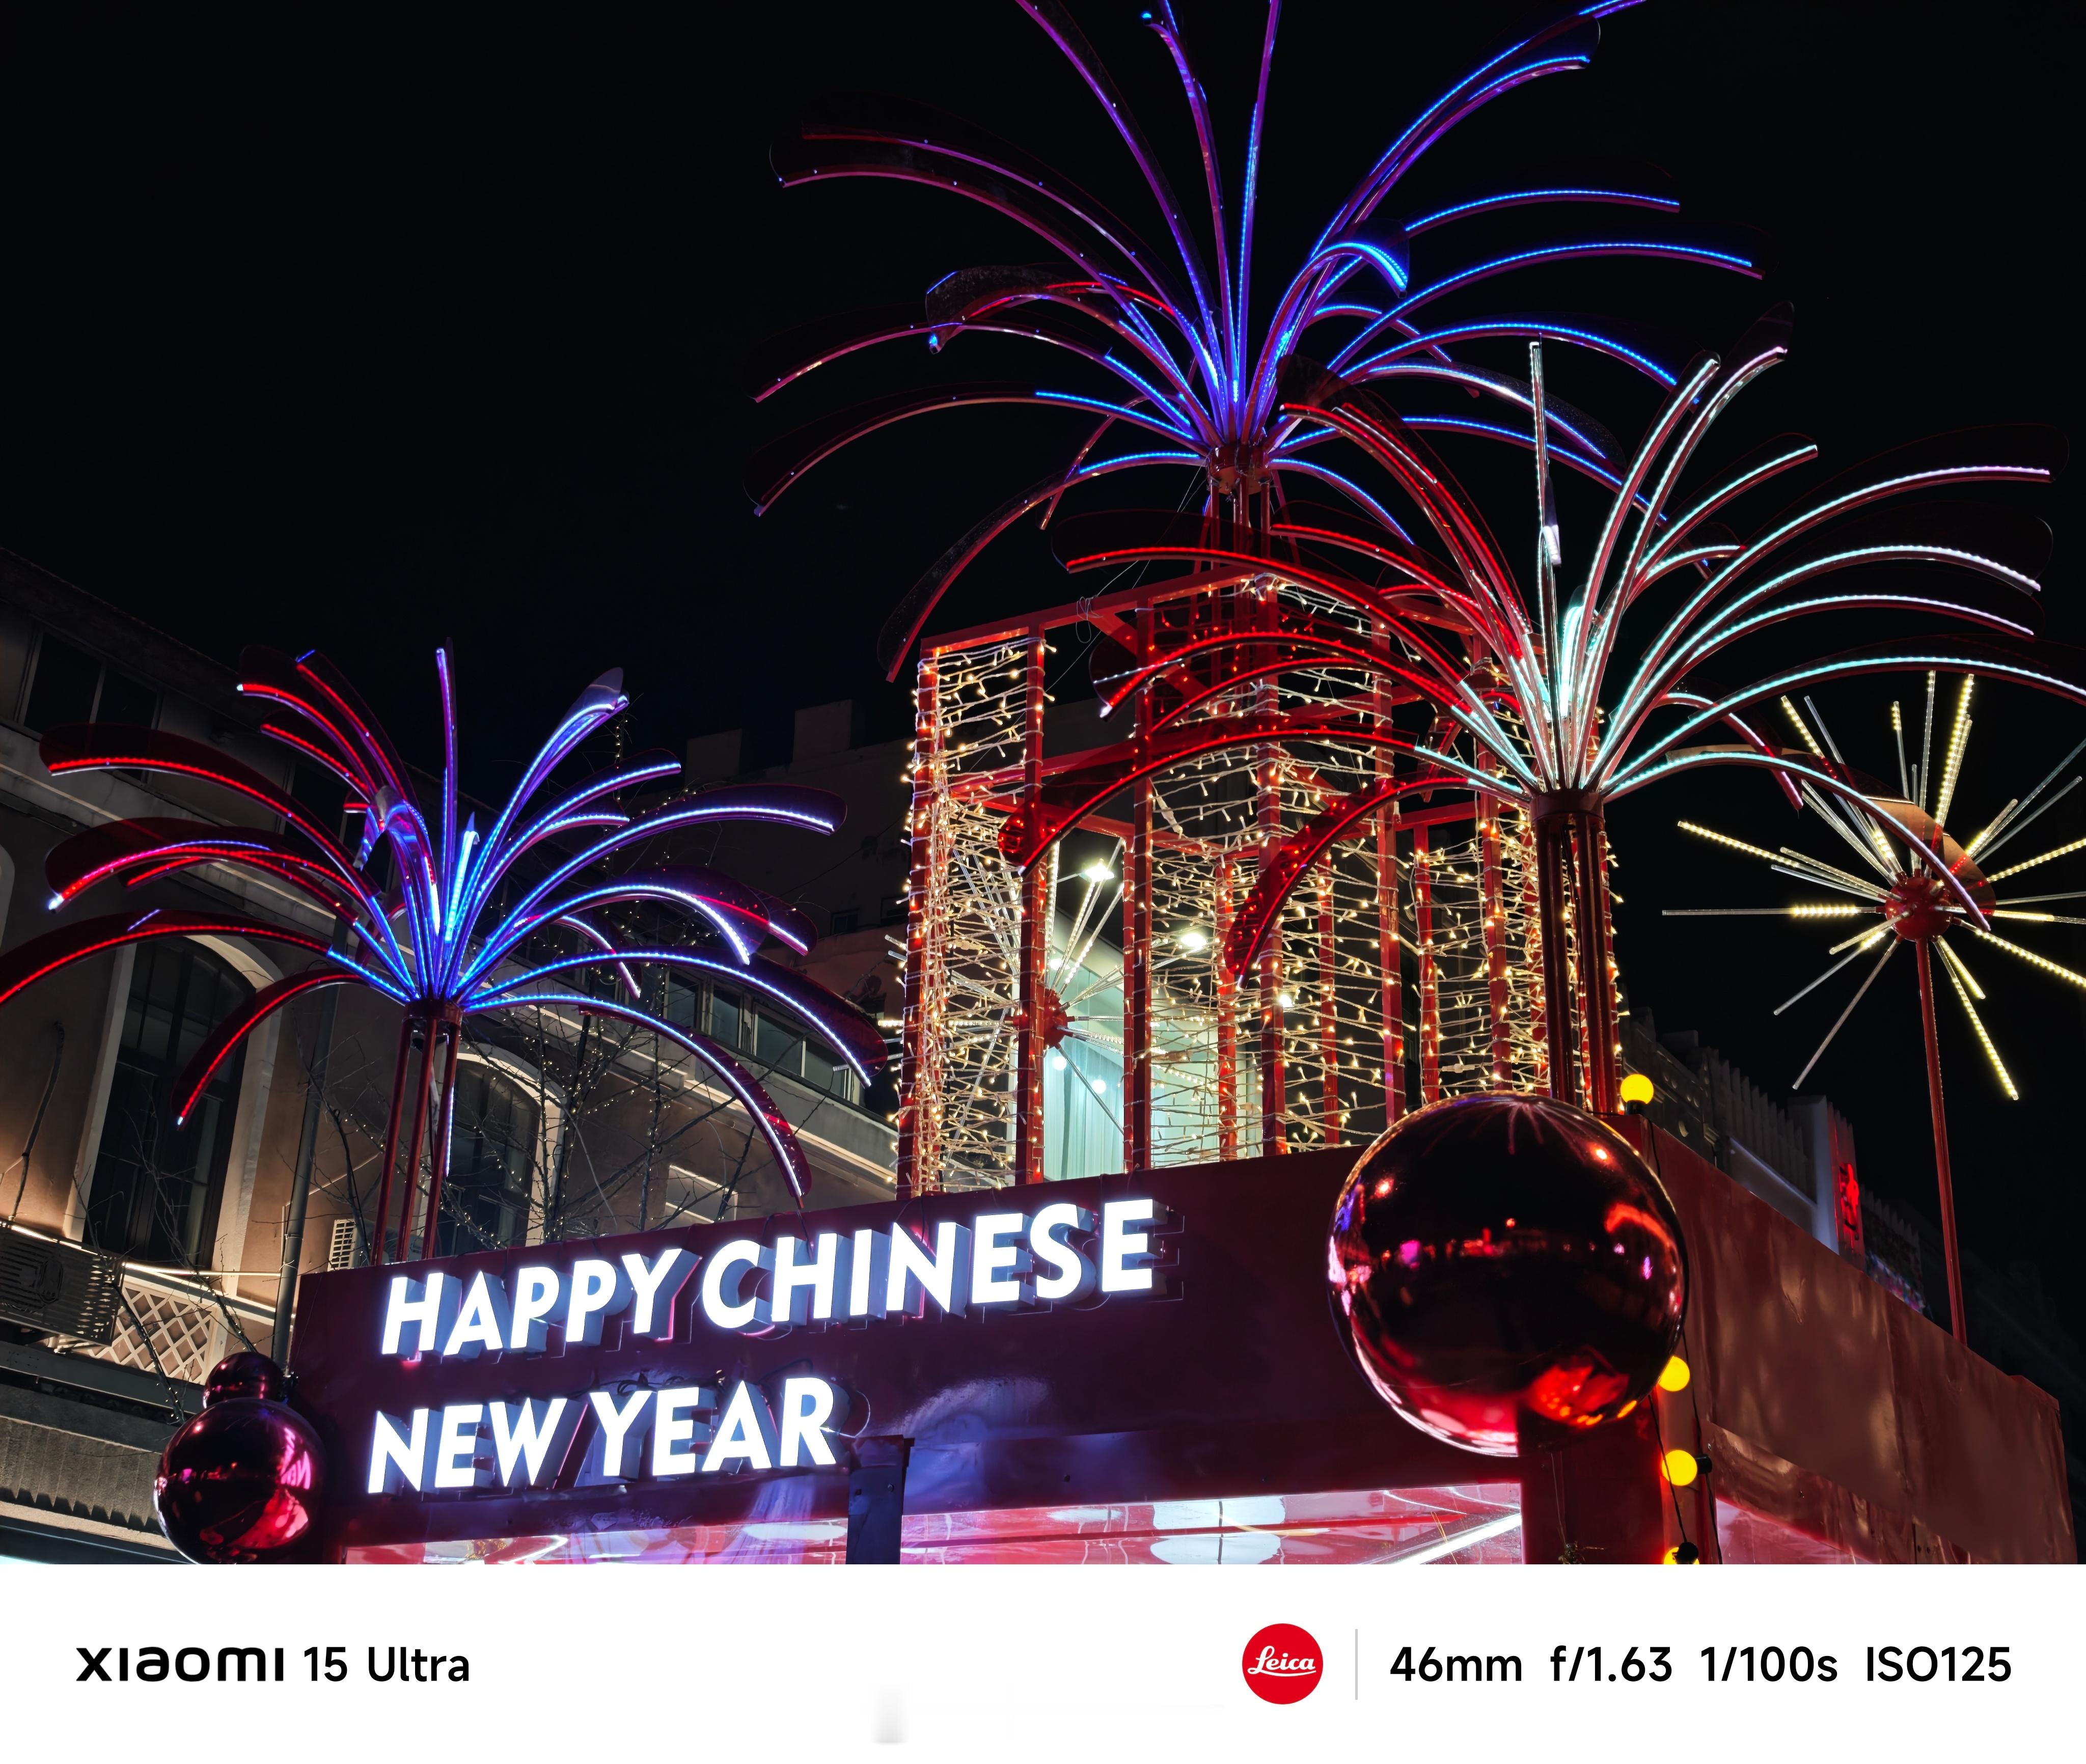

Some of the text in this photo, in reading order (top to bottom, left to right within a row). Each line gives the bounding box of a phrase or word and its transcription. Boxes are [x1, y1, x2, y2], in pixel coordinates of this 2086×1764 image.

[382, 1199, 1154, 1355] HAPPY CHINESE
[368, 1397, 567, 1493] NEW
[590, 1377, 837, 1476] YEAR
